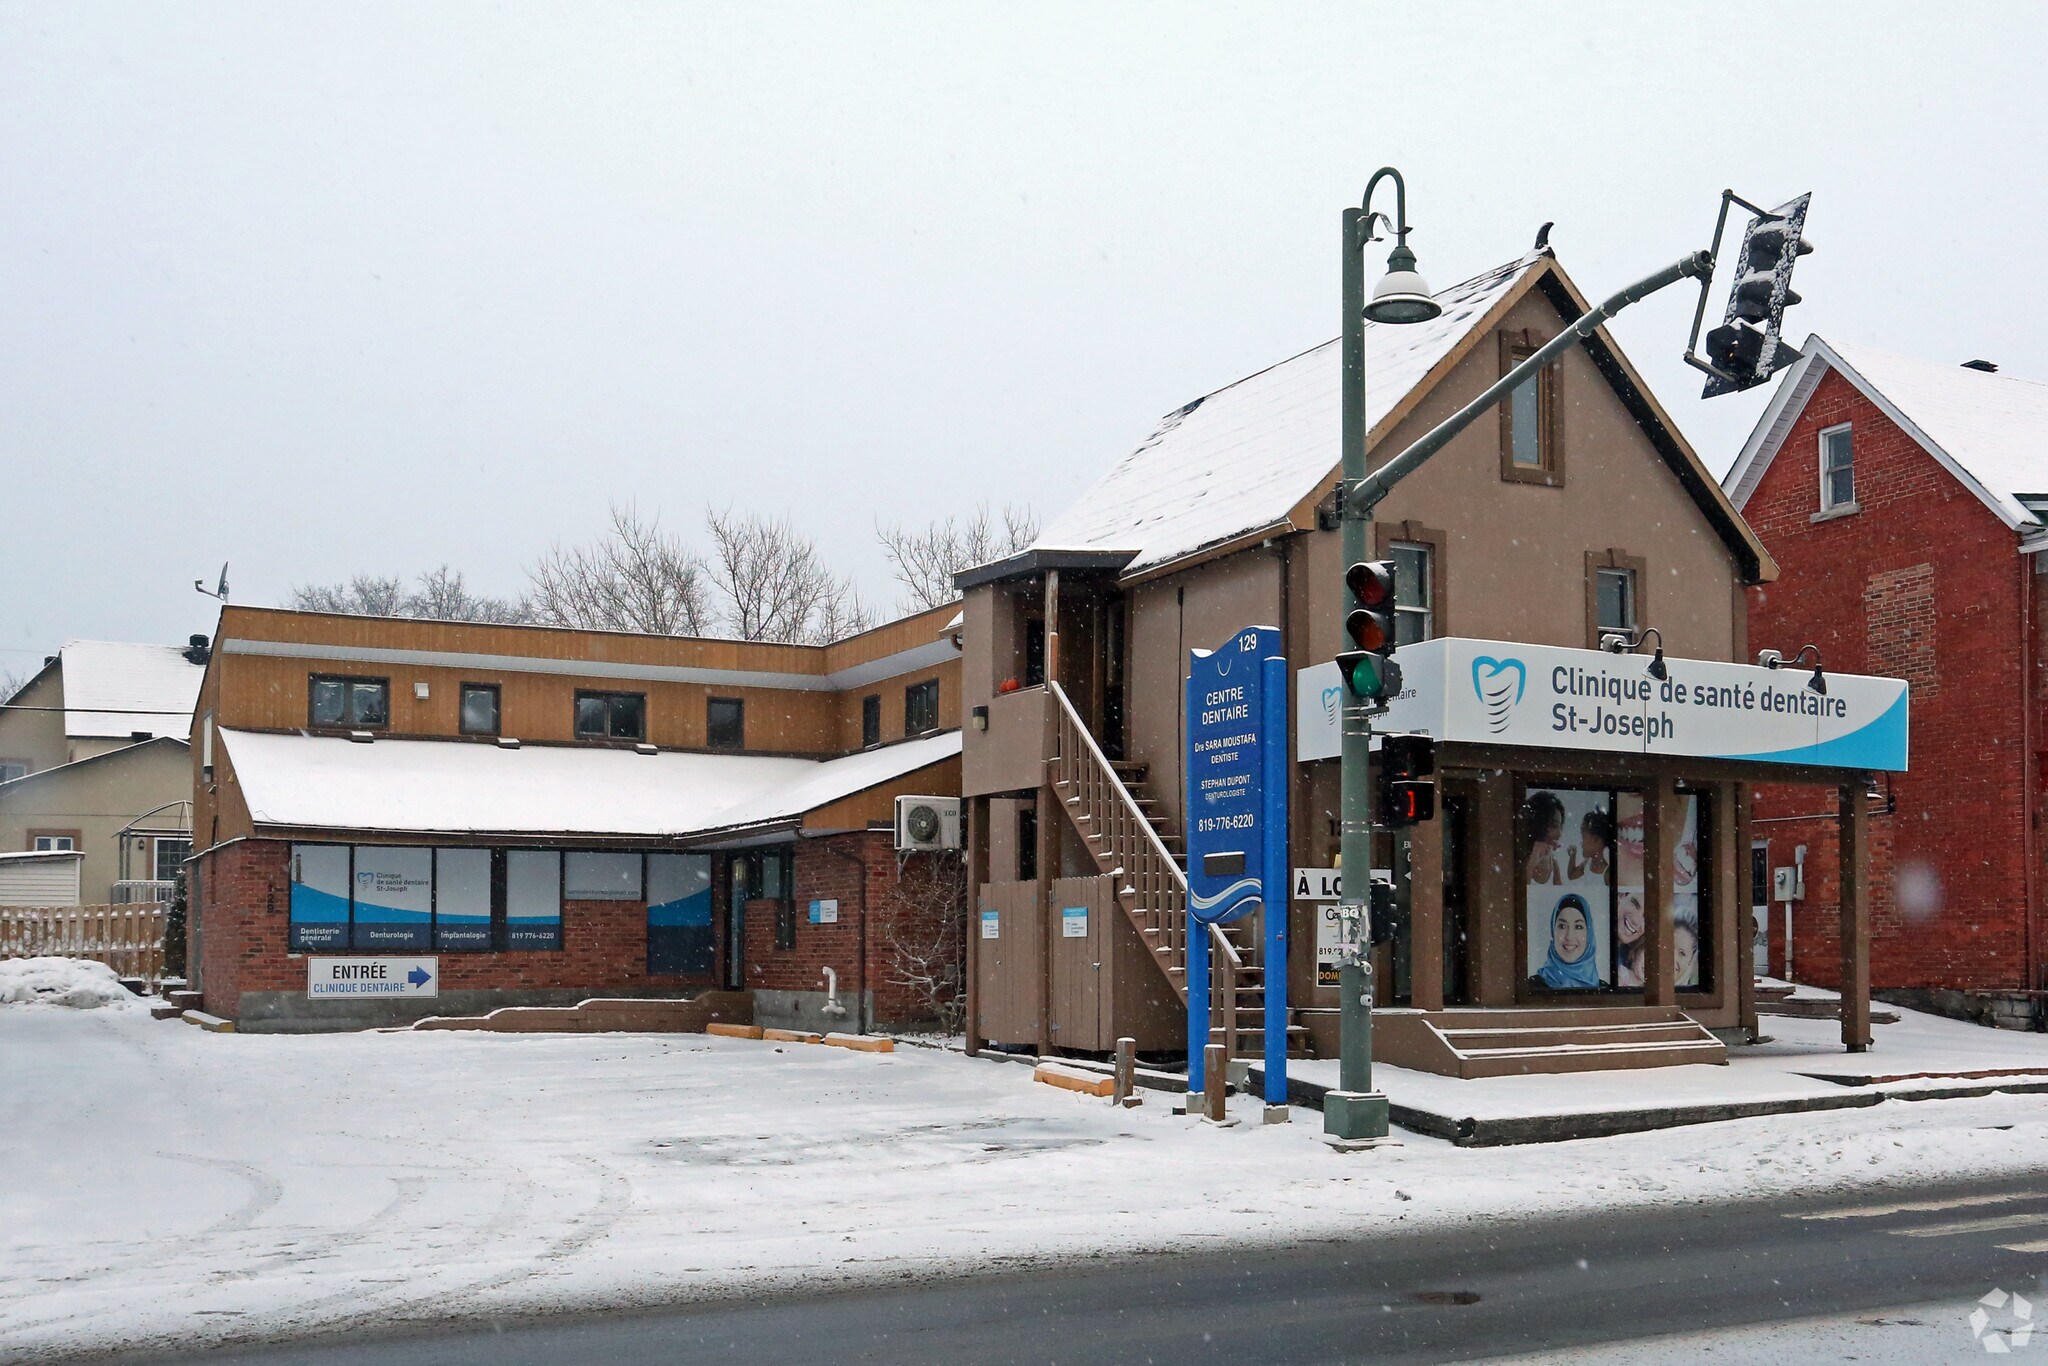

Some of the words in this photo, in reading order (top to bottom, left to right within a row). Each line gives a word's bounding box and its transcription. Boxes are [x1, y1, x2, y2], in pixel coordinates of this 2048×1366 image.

[1239, 633, 1257, 652] 129
[1206, 686, 1244, 706] CENTRE
[1552, 665, 1652, 706] Clinique
[1660, 676, 1687, 704] de
[1694, 681, 1755, 711] santé
[1761, 685, 1847, 718] dentaire
[1202, 704, 1248, 725] DENTAIRE
[1552, 702, 1674, 744] St-Joseph
[1194, 742, 1205, 753] Dre
[1205, 738, 1222, 751] SARA
[1222, 733, 1256, 748] MOUSTAFA
[1211, 752, 1239, 764] DENTISTE
[1201, 778, 1227, 790] STEPHAN
[1227, 774, 1251, 787] DUPONT
[1205, 788, 1246, 801] DENTUROLOGISTE
[1198, 814, 1254, 832] 819-776-6220
[1297, 870, 1310, 896] À
[300, 934, 332, 943] générale
[370, 931, 414, 939] Denturologie
[440, 932, 486, 940] Implantologie
[526, 932, 555, 940] 776-6220
[332, 961, 387, 979] ENTRÉE
[313, 983, 358, 993] CLINIQUE
[360, 982, 405, 992] DENTAIRE
